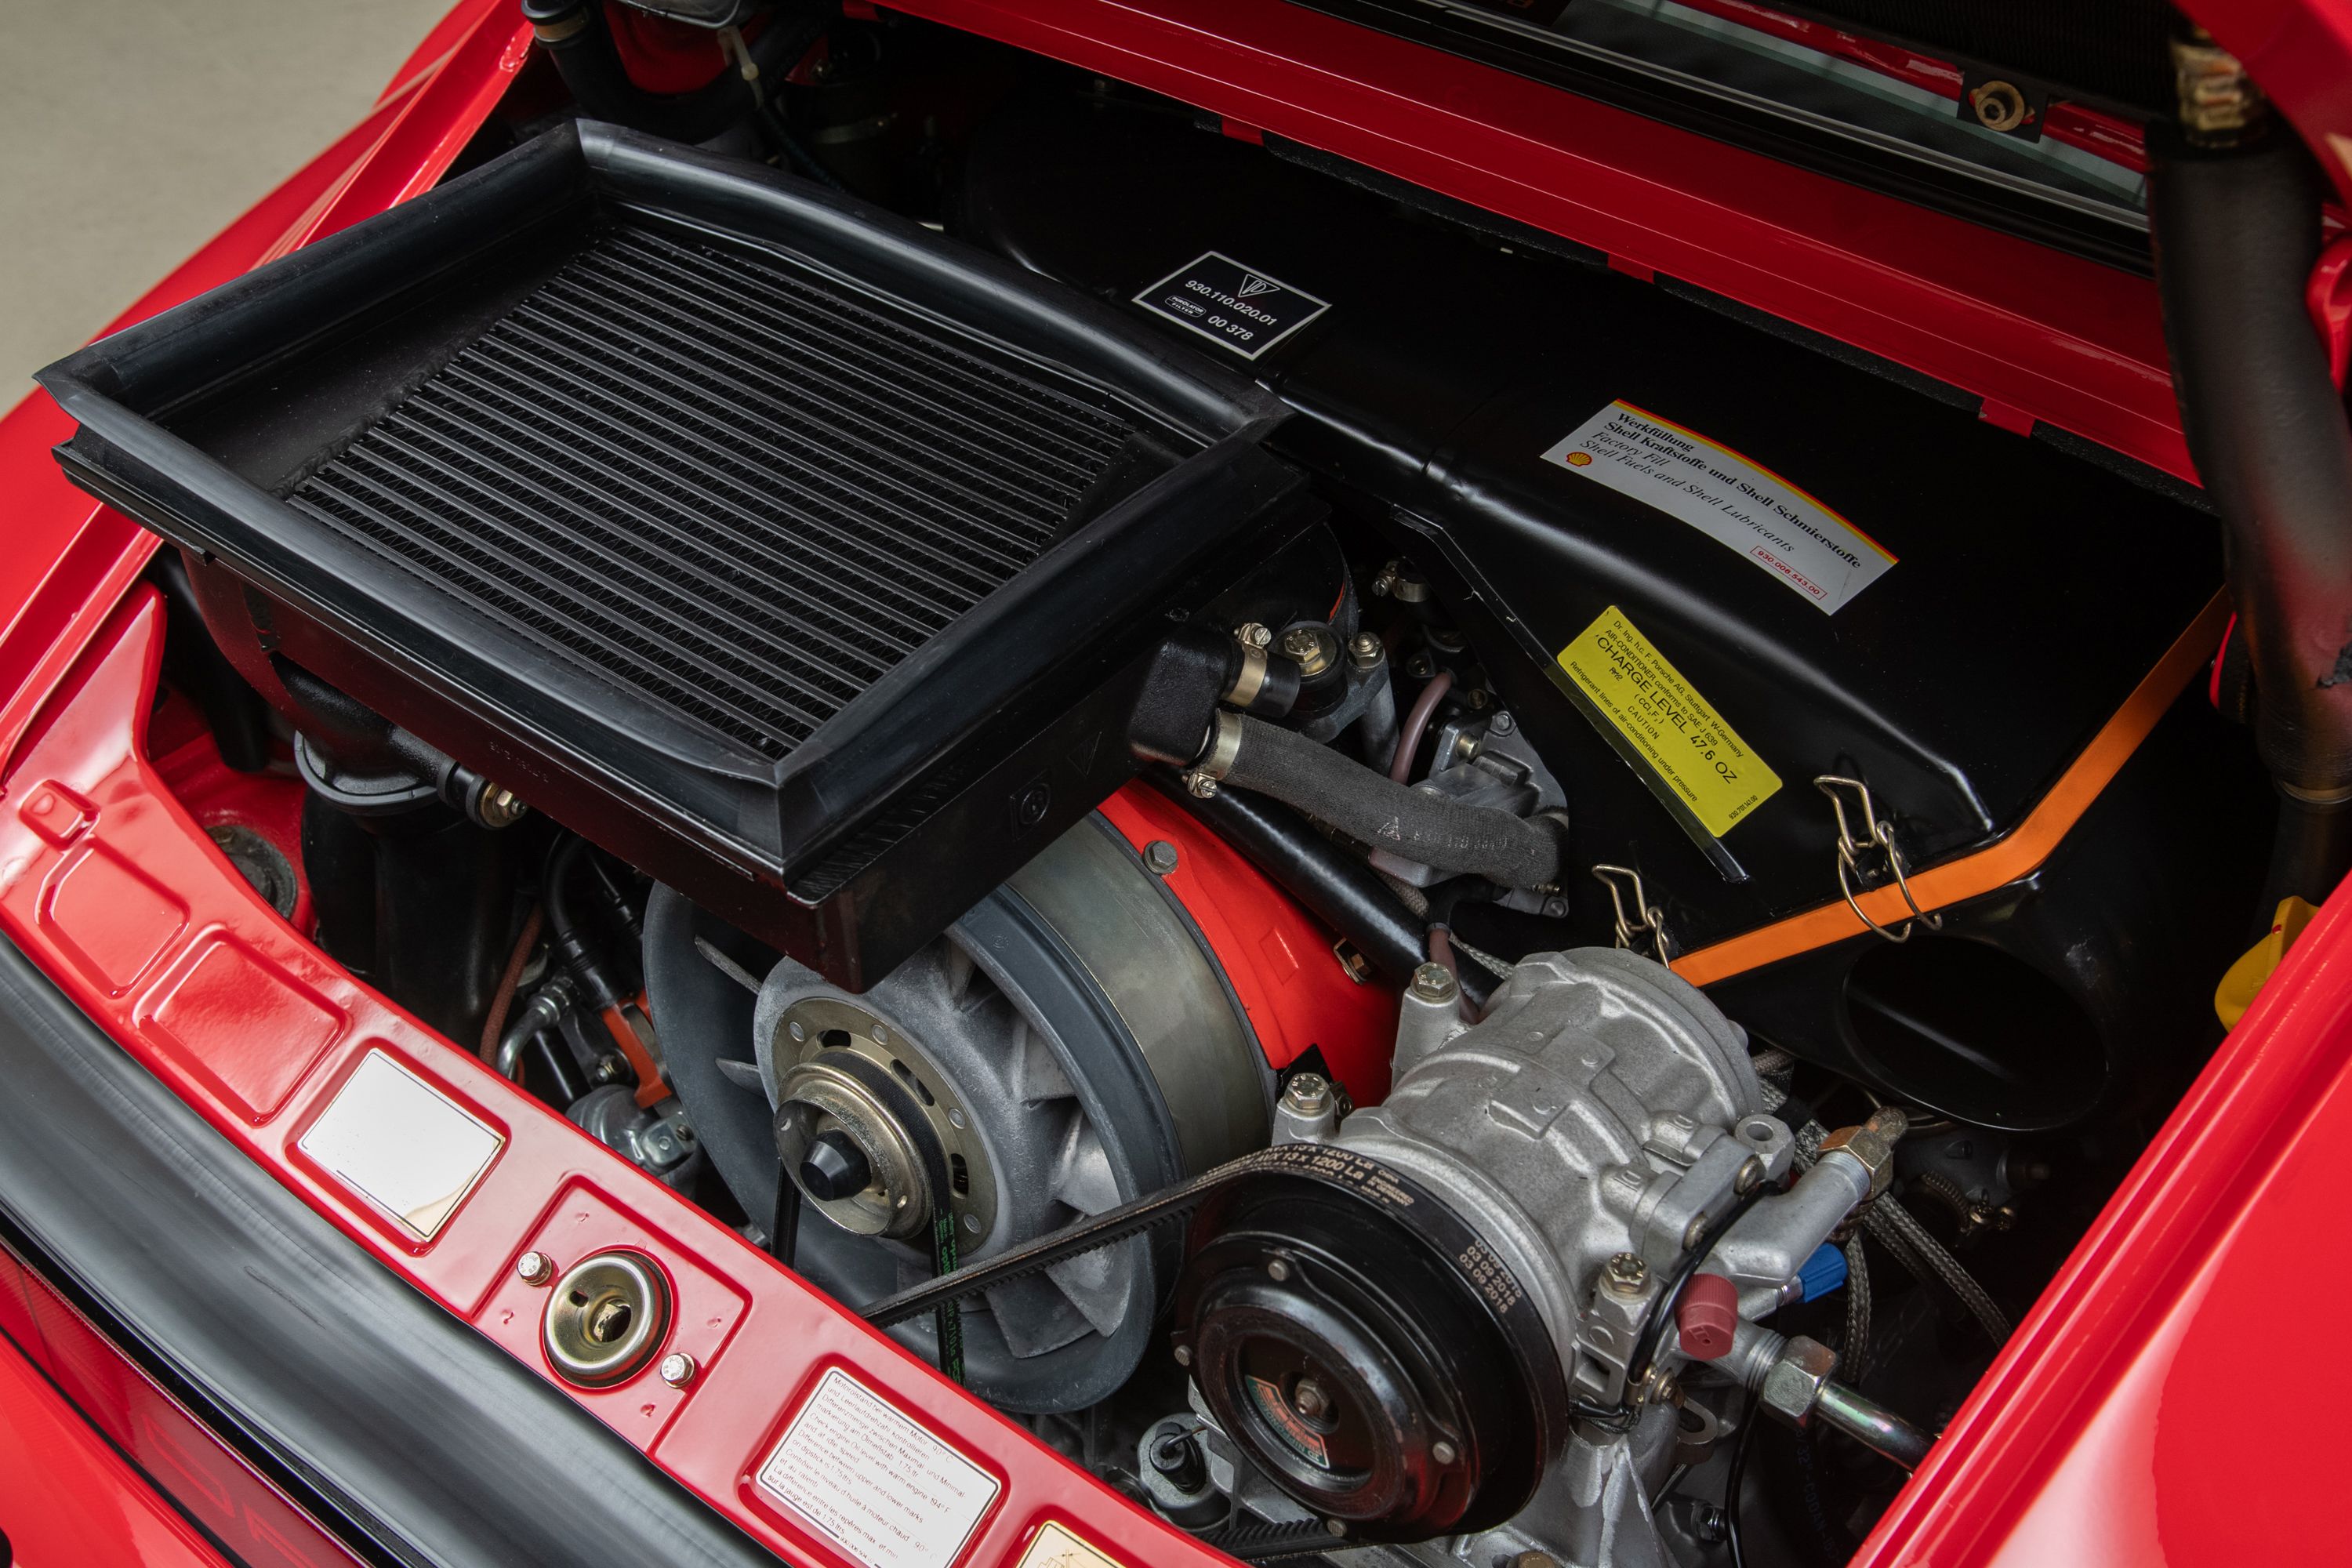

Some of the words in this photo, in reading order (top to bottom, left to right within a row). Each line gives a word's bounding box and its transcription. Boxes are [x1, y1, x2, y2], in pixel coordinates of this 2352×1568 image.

[1171, 303, 1193, 314] FILTER
[1185, 280, 1277, 325] 930.110.020.01
[1207, 315, 1228, 327] 00
[1225, 324, 1254, 340] 378
[1591, 431, 1642, 458] Factory
[1642, 452, 1671, 466] Fill
[1617, 412, 1694, 452] Werkfüllung
[1579, 440, 1619, 458] Shell
[1615, 452, 1654, 474] Fuels
[1653, 473, 1686, 487] and
[1682, 485, 1723, 506] Shell
[1720, 505, 1794, 552] Lubricants
[1603, 422, 1641, 441] Shell
[1639, 431, 1707, 470] Kraftstoffe
[1708, 469, 1737, 485] und
[1736, 483, 1774, 506] Shell
[1773, 505, 1860, 568] Schmierstoffe
[1757, 550, 1824, 594] 930.006.543.00
[1604, 630, 1656, 681] AIR-CONDITIONER
[1654, 680, 1682, 708] conforms
[1680, 706, 1688, 715] to
[1686, 713, 1702, 728] SAE
[1704, 732, 1718, 746] 639
[1613, 620, 1623, 630] Dr.
[1622, 630, 1633, 644] Ing.
[1633, 641, 1644, 654] h.c.
[1650, 659, 1675, 684] Porsche
[1672, 683, 1685, 696] AG,
[1684, 694, 1711, 721] Stuttgart
[1711, 720, 1744, 757] W-Germany
[1570, 661, 1600, 694] Refrigerant
[1599, 691, 1613, 708] lines
[1617, 713, 1659, 759] air-conditioning
[1657, 757, 1675, 775] under
[1671, 775, 1697, 802] pressure
[1597, 637, 1653, 693] CHARGE
[1649, 690, 1687, 734] LEVEL
[1690, 735, 1715, 760] 47.6
[1715, 761, 1737, 784] OZ
[1628, 706, 1660, 739] CAUTION
[1728, 794, 1758, 820] 930.701.141.00
[1312, 1155, 1346, 1171] 1200
[1344, 1165, 1365, 1181] La
[1459, 1254, 1475, 1270] 03
[1472, 1269, 1487, 1285] 09
[1484, 1283, 1508, 1314] 2018
[1467, 1246, 1482, 1263] 03
[1480, 1261, 1495, 1277] 09
[1491, 1276, 1516, 1307] 2018
[804, 1423, 818, 1433] and
[827, 1387, 840, 1397] und
[891, 1431, 930, 1461] kontrollieren
[909, 1429, 927, 1444] Motor
[810, 1412, 828, 1429] Check
[829, 1428, 850, 1443] engine
[860, 1448, 876, 1462] level
[875, 1460, 888, 1471] with
[888, 1470, 906, 1484] warm
[906, 1483, 927, 1499] engine
[926, 1469, 940, 1480] und
[768, 1475, 779, 1484] sur
[802, 1501, 813, 1510] est
[812, 1495, 829, 1508] entre
[828, 1505, 837, 1516] les
[855, 1472, 873, 1486] upper
[873, 1485, 887, 1496] and
[886, 1493, 903, 1508] lower
[903, 1506, 923, 1523] marks
[866, 1508, 889, 1526] moteur
[888, 1525, 909, 1541] chaud
